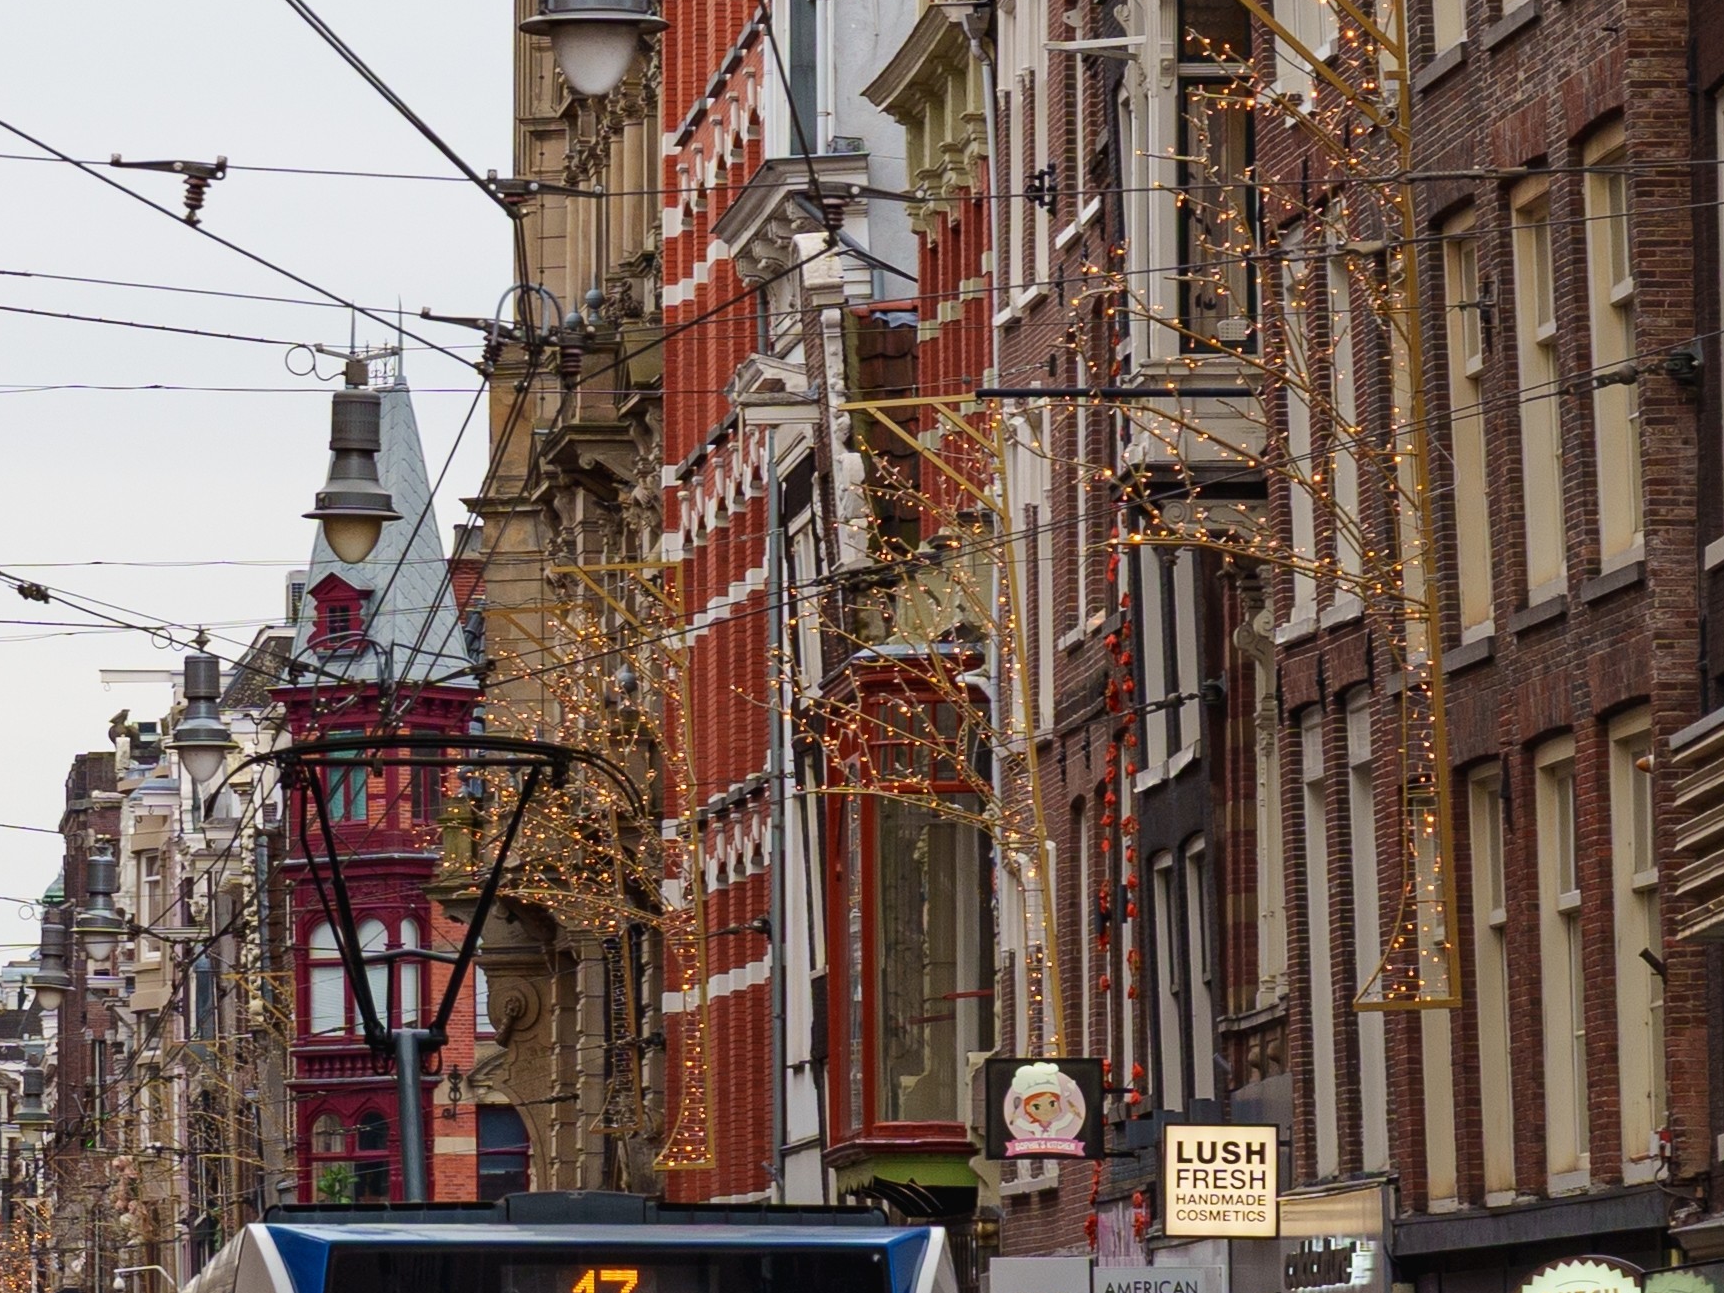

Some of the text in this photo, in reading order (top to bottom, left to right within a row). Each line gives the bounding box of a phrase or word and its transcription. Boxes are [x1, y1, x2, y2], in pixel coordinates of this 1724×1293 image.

[1176, 1140, 1267, 1165] LUSH
[1176, 1168, 1267, 1190] FRESH
[1175, 1193, 1267, 1207] HANDMADE
[1176, 1209, 1267, 1223] COSMETICS
